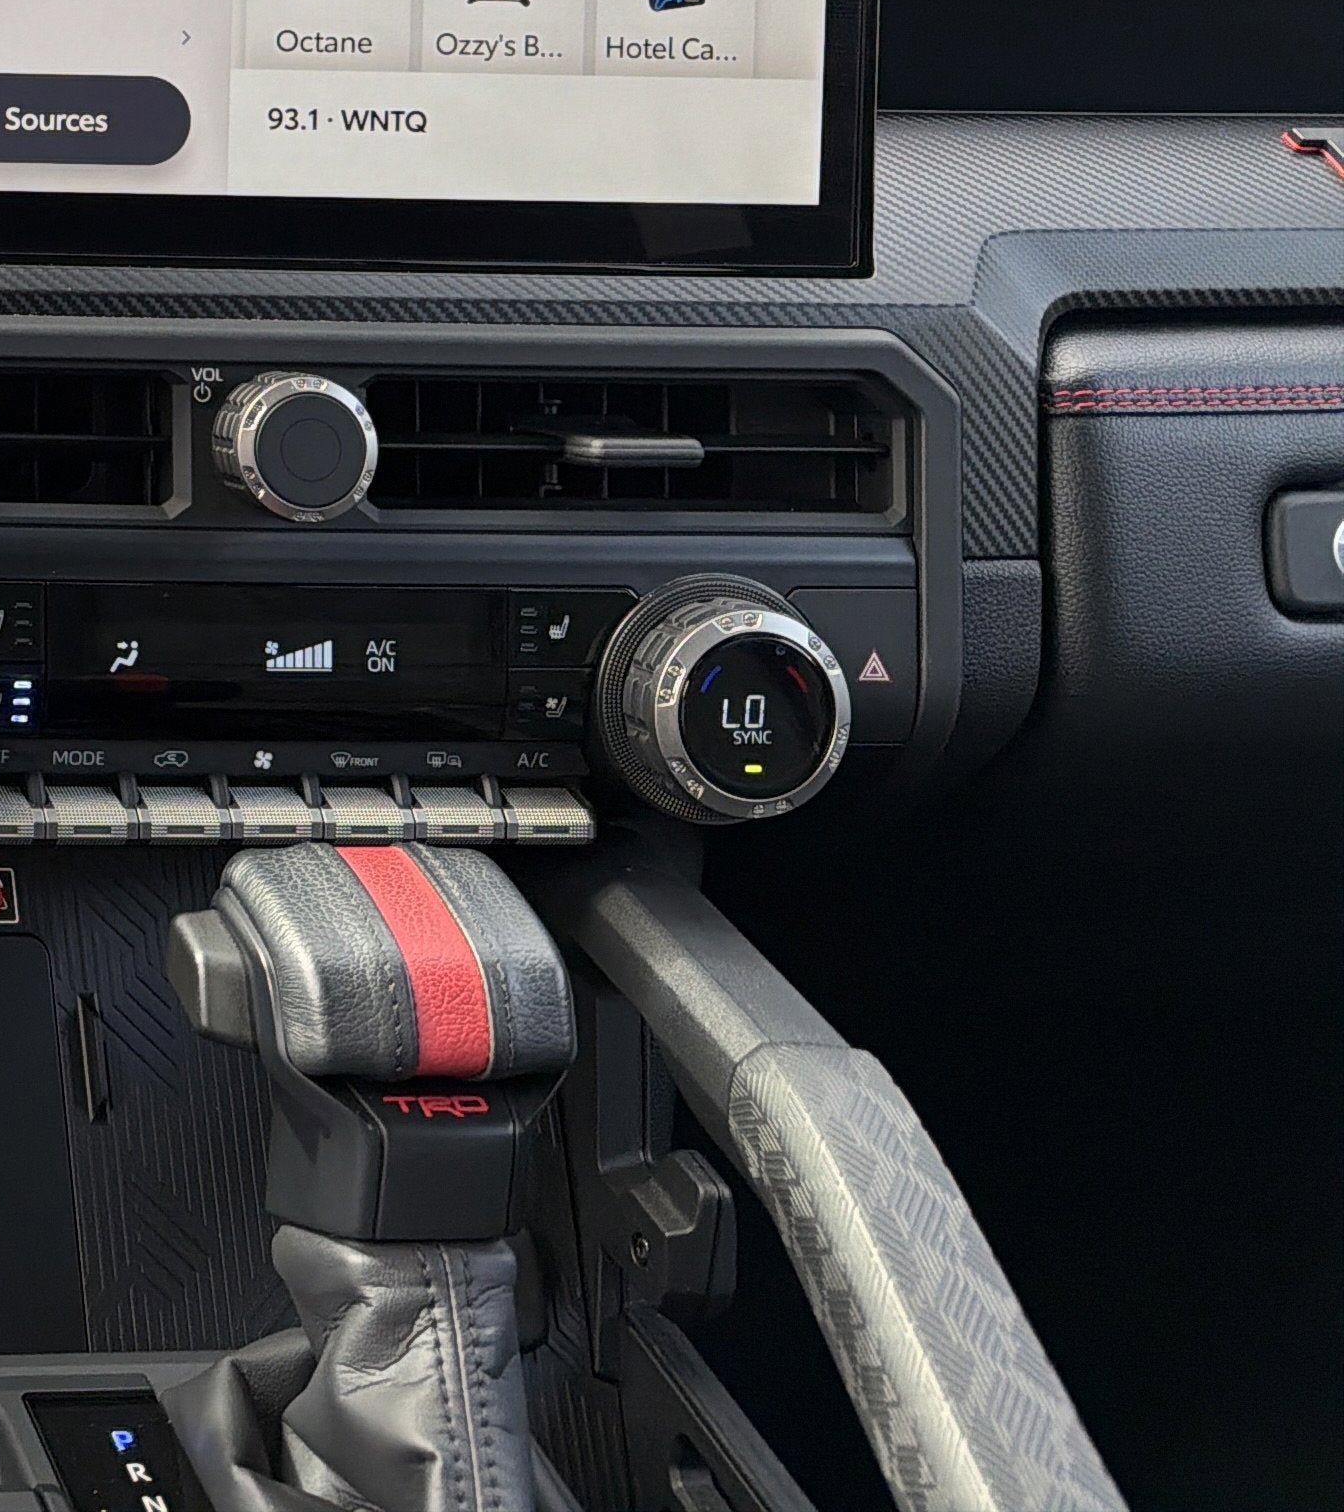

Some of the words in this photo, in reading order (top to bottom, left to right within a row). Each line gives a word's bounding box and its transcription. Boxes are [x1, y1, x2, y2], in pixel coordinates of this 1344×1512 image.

[276, 31, 373, 55] Octane
[436, 33, 516, 60] Ozzy's
[606, 36, 675, 60] Hotel
[682, 39, 738, 62] Ca...
[4, 106, 109, 133] Sources
[267, 108, 319, 131] 93.1
[341, 110, 428, 134] WNTQ
[191, 367, 224, 383] VOL
[366, 640, 397, 656] A/C
[367, 657, 395, 673] ON
[722, 694, 765, 729] LO
[733, 730, 773, 746] SYNC
[52, 750, 105, 765] MODE
[349, 757, 379, 767] FRONT
[517, 751, 549, 769] A/C
[383, 1096, 490, 1117] TRD
[112, 1430, 134, 1452] P
[125, 1462, 153, 1483] R
[141, 1495, 168, 1512] N
